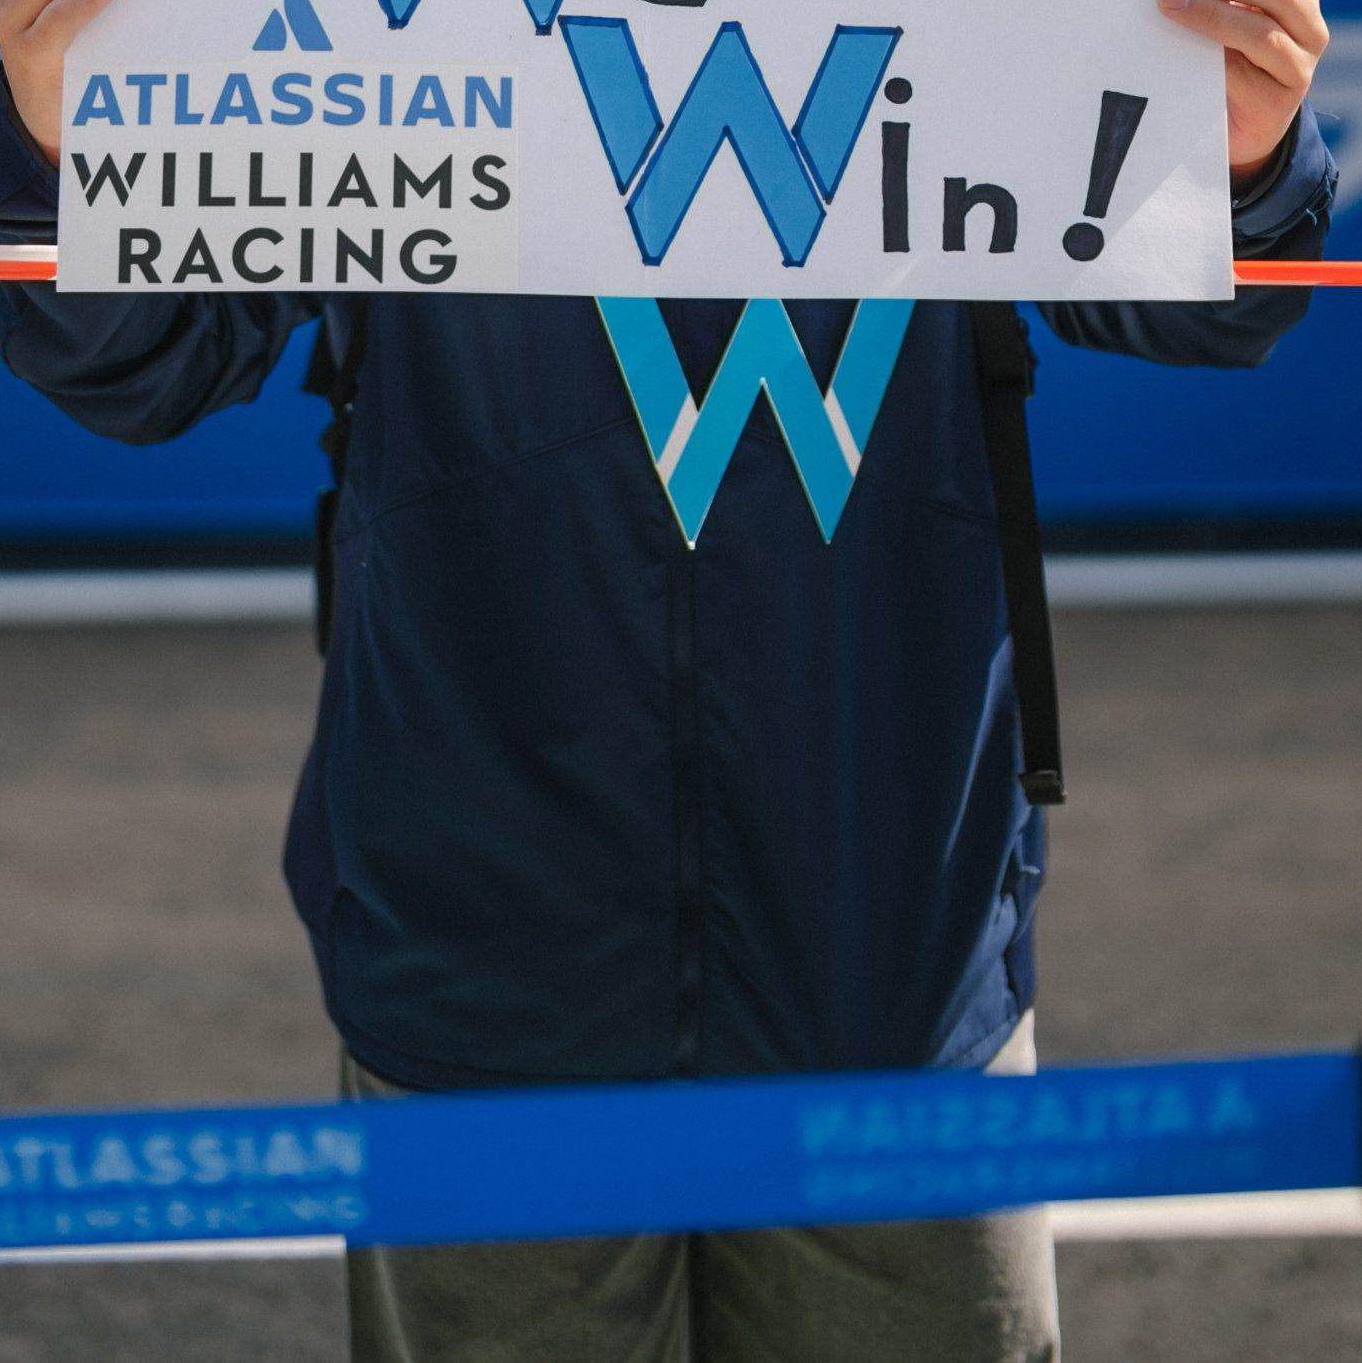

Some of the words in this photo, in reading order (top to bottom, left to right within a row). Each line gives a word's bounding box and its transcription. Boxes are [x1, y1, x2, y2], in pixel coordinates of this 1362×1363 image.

[72, 71, 514, 129] ATLASSIAN
[71, 151, 512, 211] WILLIAMS
[117, 227, 459, 286] RACING
